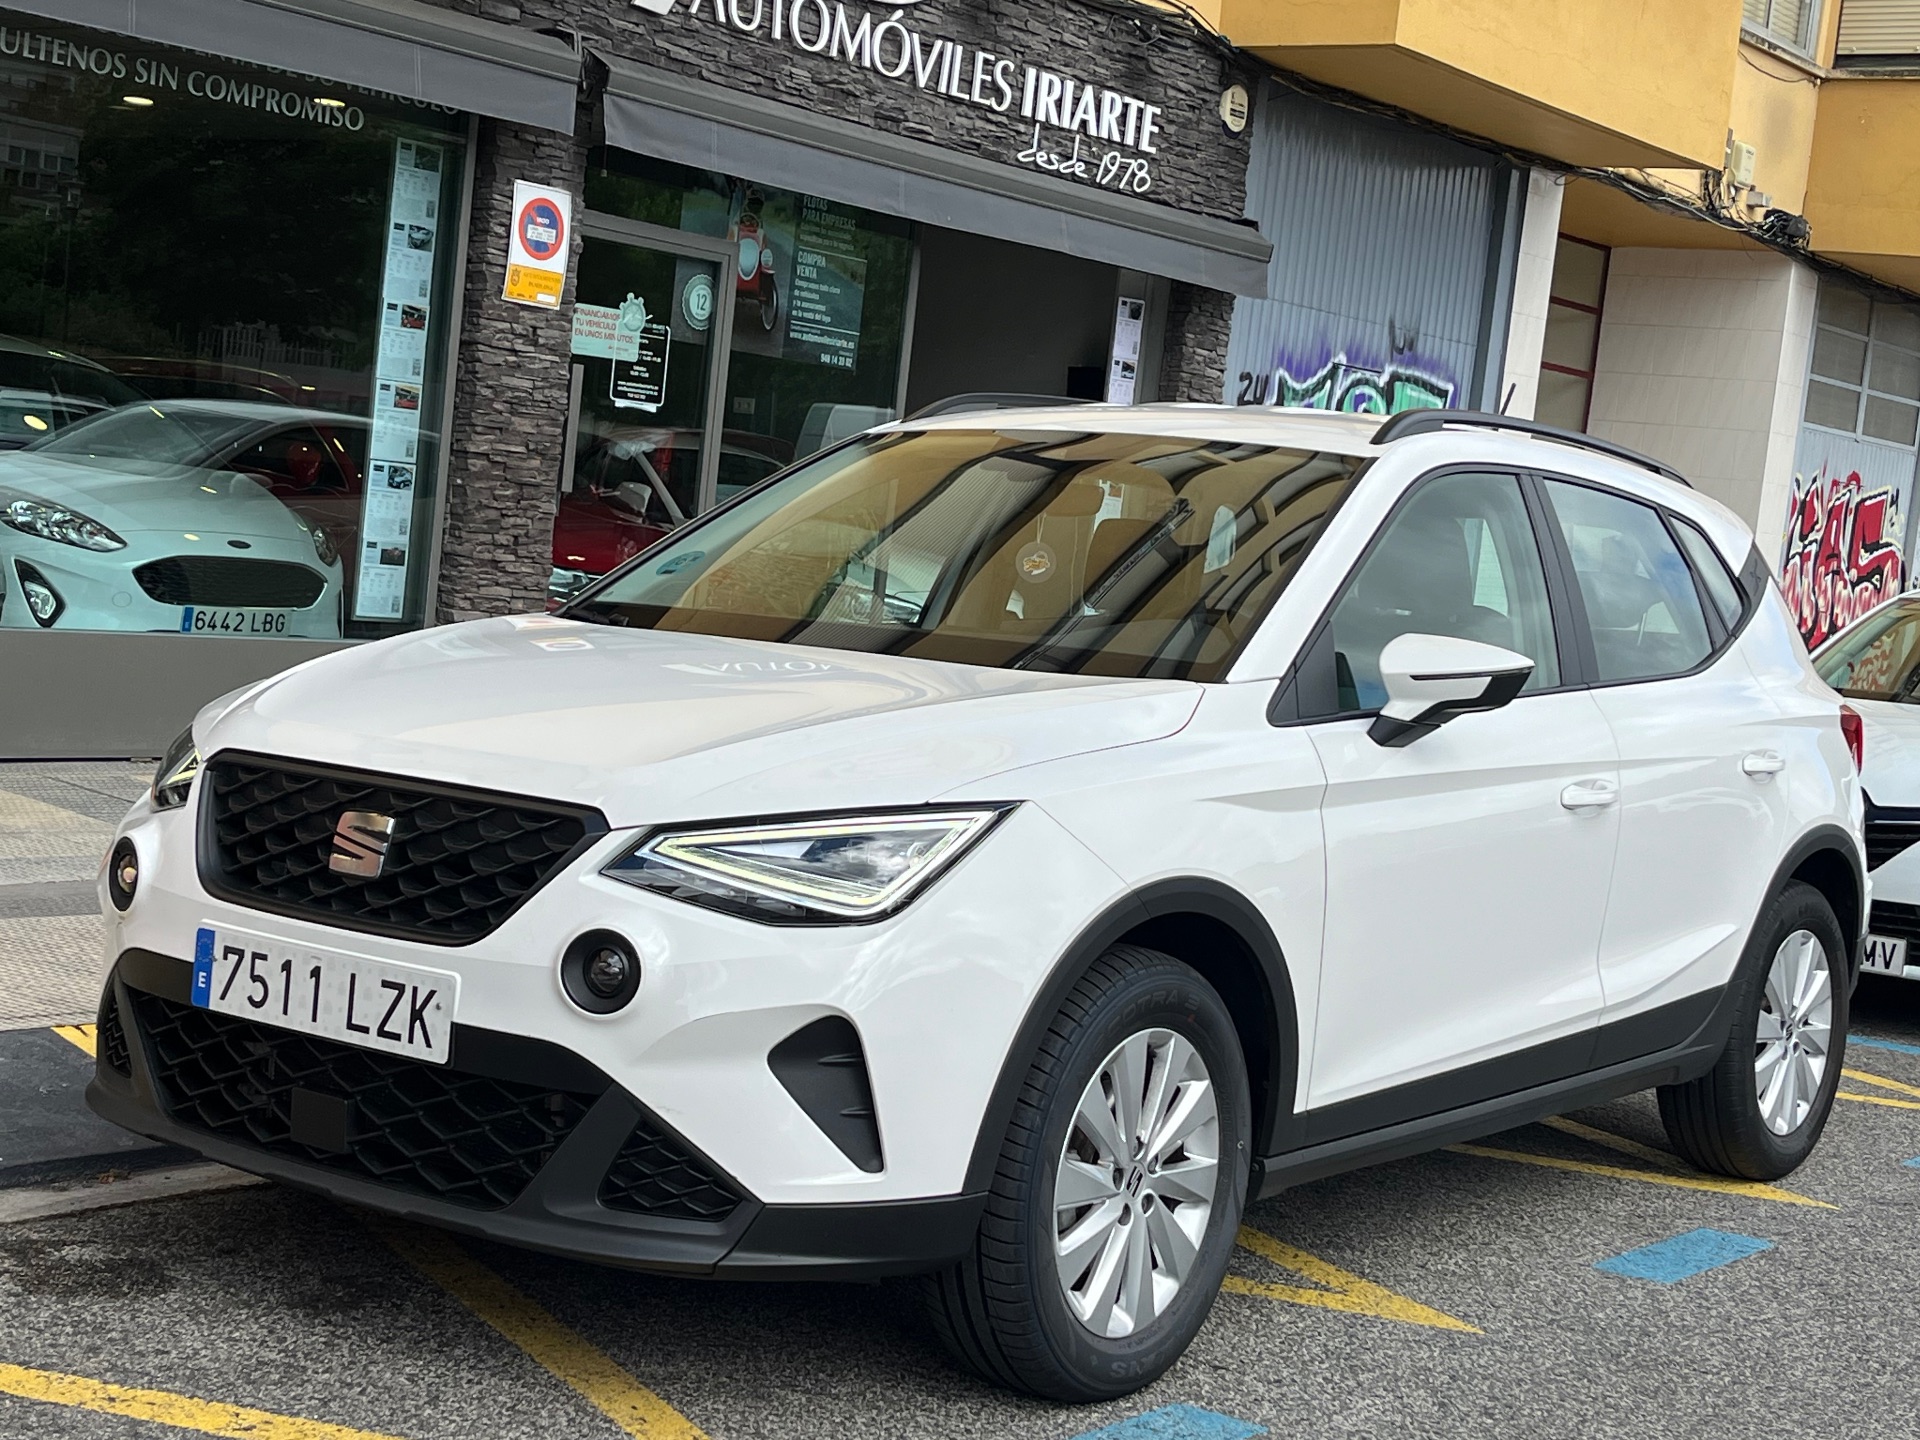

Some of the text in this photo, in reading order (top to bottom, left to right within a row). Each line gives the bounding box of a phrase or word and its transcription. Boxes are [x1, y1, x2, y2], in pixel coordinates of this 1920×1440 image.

[134, 57, 179, 91] SIN
[187, 70, 365, 131] COMPROMISO
[1020, 67, 1162, 154] IRIARTE
[1017, 122, 1151, 193] desde 1978
[797, 251, 826, 268] COMPRA
[796, 264, 817, 279] VENTA
[696, 293, 708, 311] 12
[194, 610, 286, 632] 6442 LBG
[197, 971, 207, 988] E
[219, 945, 438, 1049] 7511 LZK
